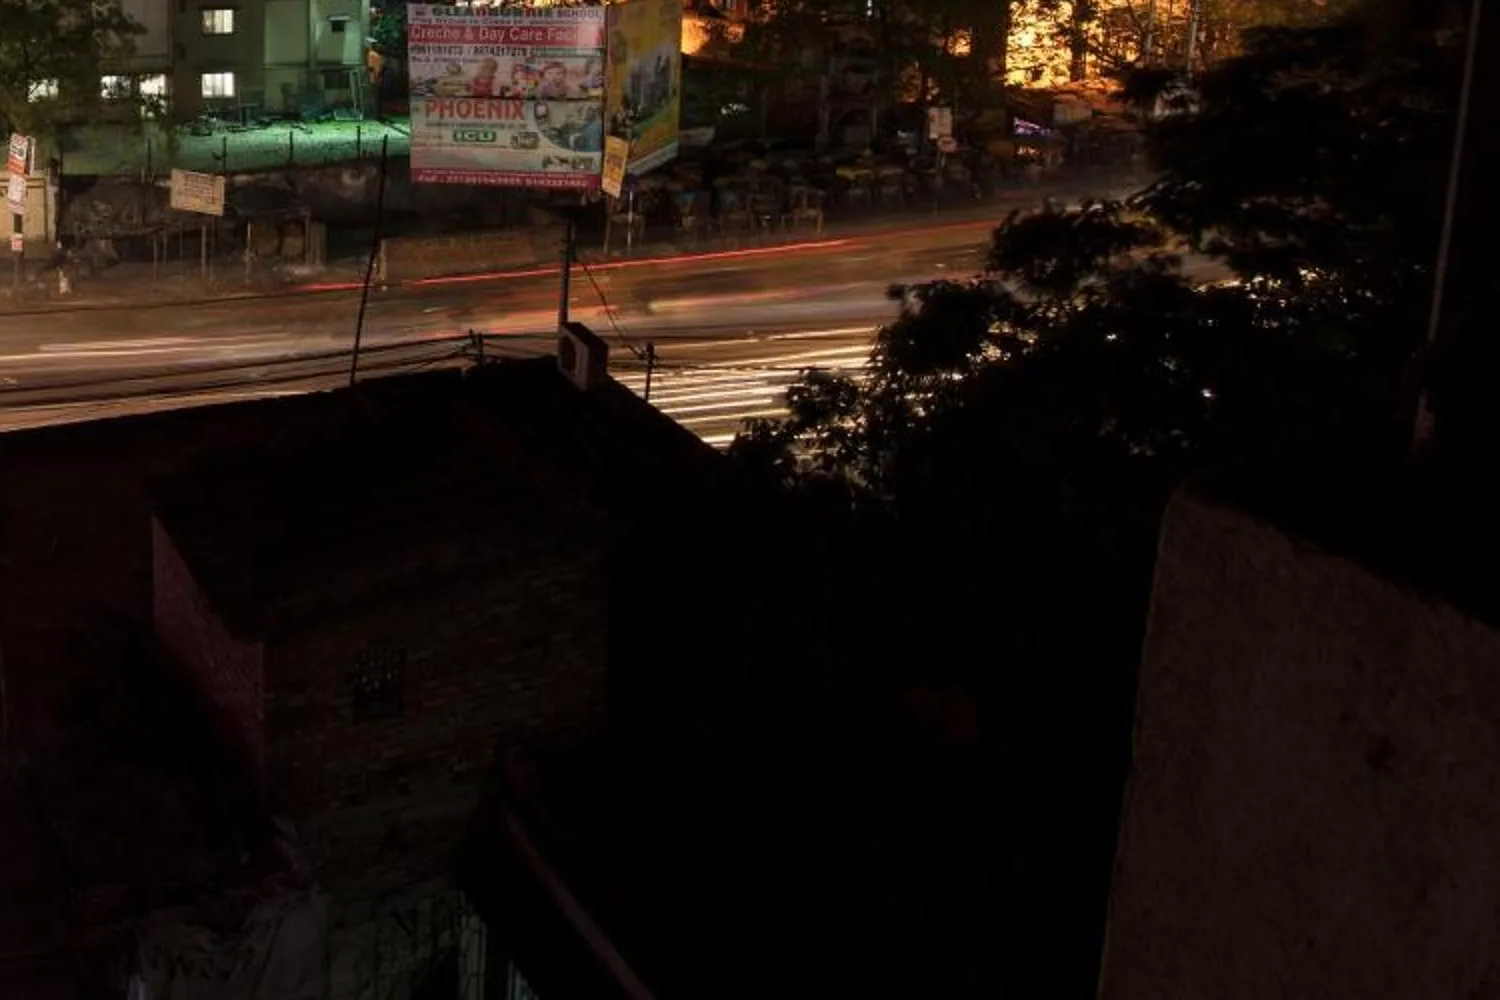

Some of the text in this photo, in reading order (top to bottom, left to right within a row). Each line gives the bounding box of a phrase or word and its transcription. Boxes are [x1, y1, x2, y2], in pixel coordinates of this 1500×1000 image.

[411, 26, 461, 42] Creche
[479, 27, 505, 45] Day
[509, 27, 543, 42] Care
[425, 99, 525, 121] PHOENIX
